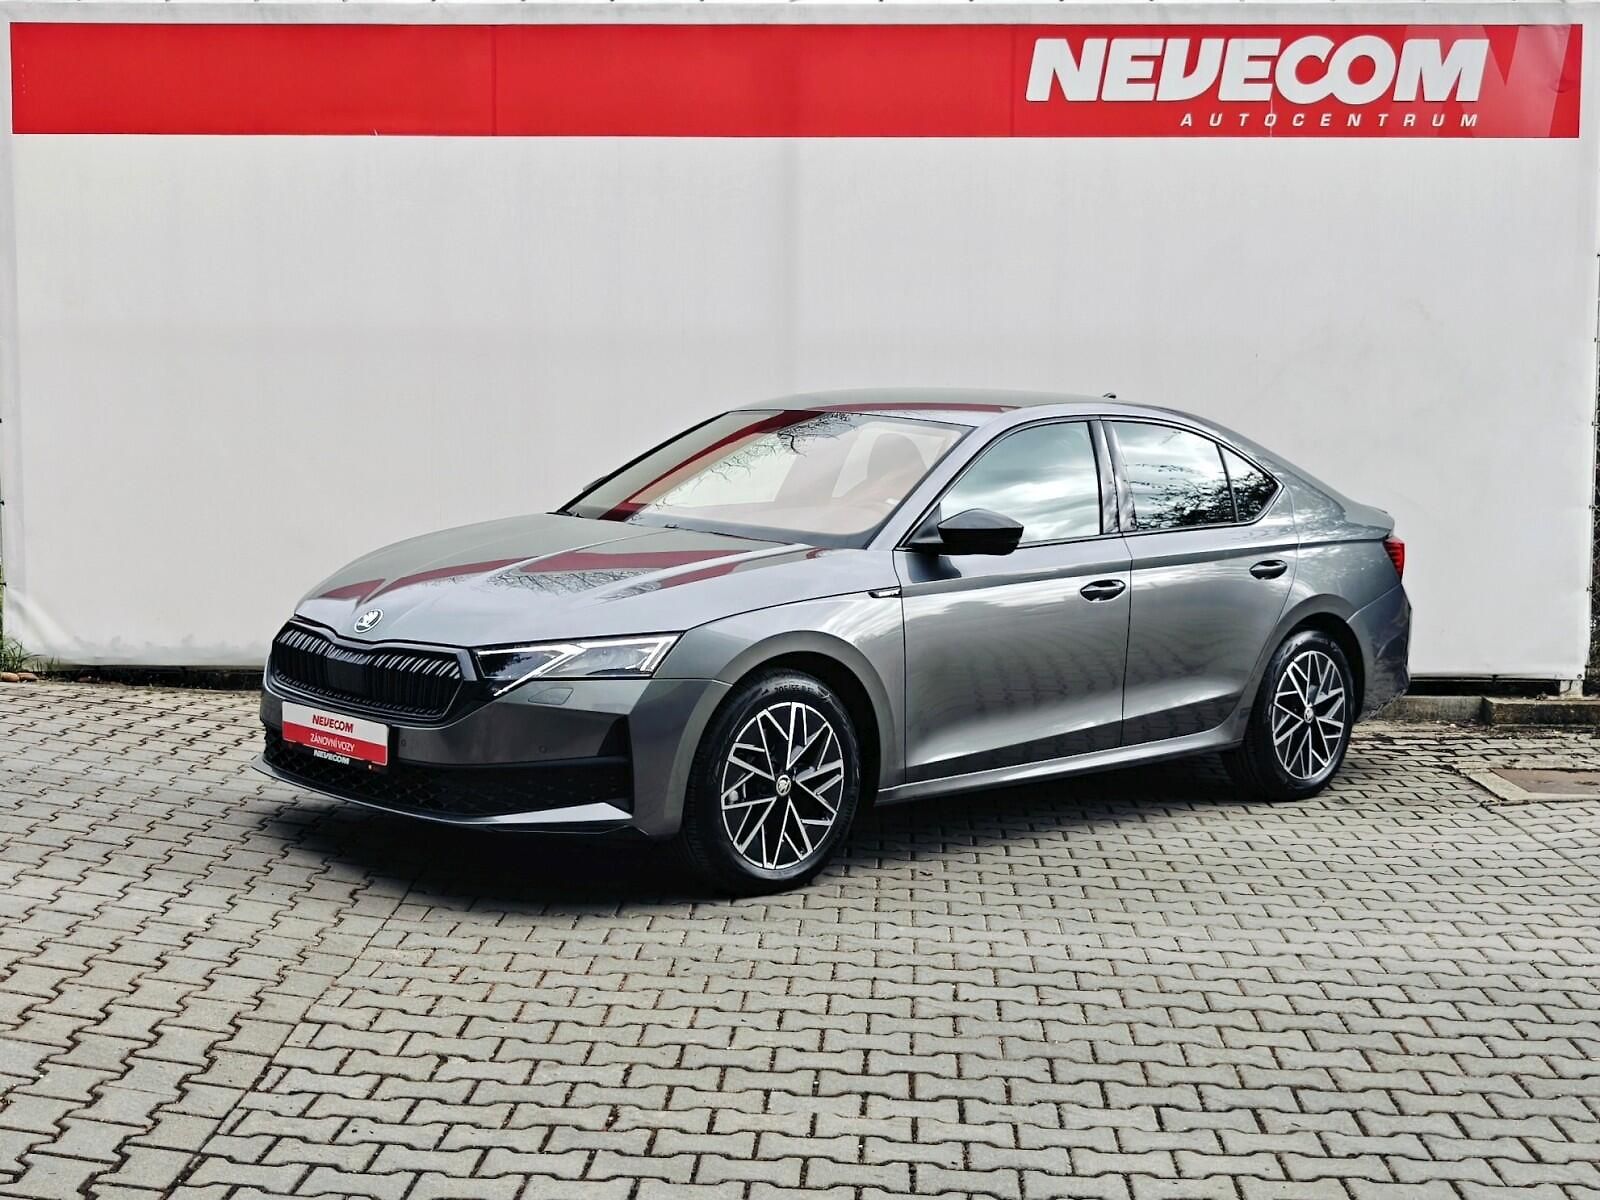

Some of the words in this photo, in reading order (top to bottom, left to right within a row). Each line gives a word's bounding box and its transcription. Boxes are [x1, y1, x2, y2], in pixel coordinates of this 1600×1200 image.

[1025, 35, 1489, 105] NEVECOM
[1180, 112, 1478, 128] AUTOCENTRUM
[312, 714, 354, 733] NEVECOM
[310, 732, 338, 748] ZÁNOVNÍ
[337, 740, 356, 752] VOZY
